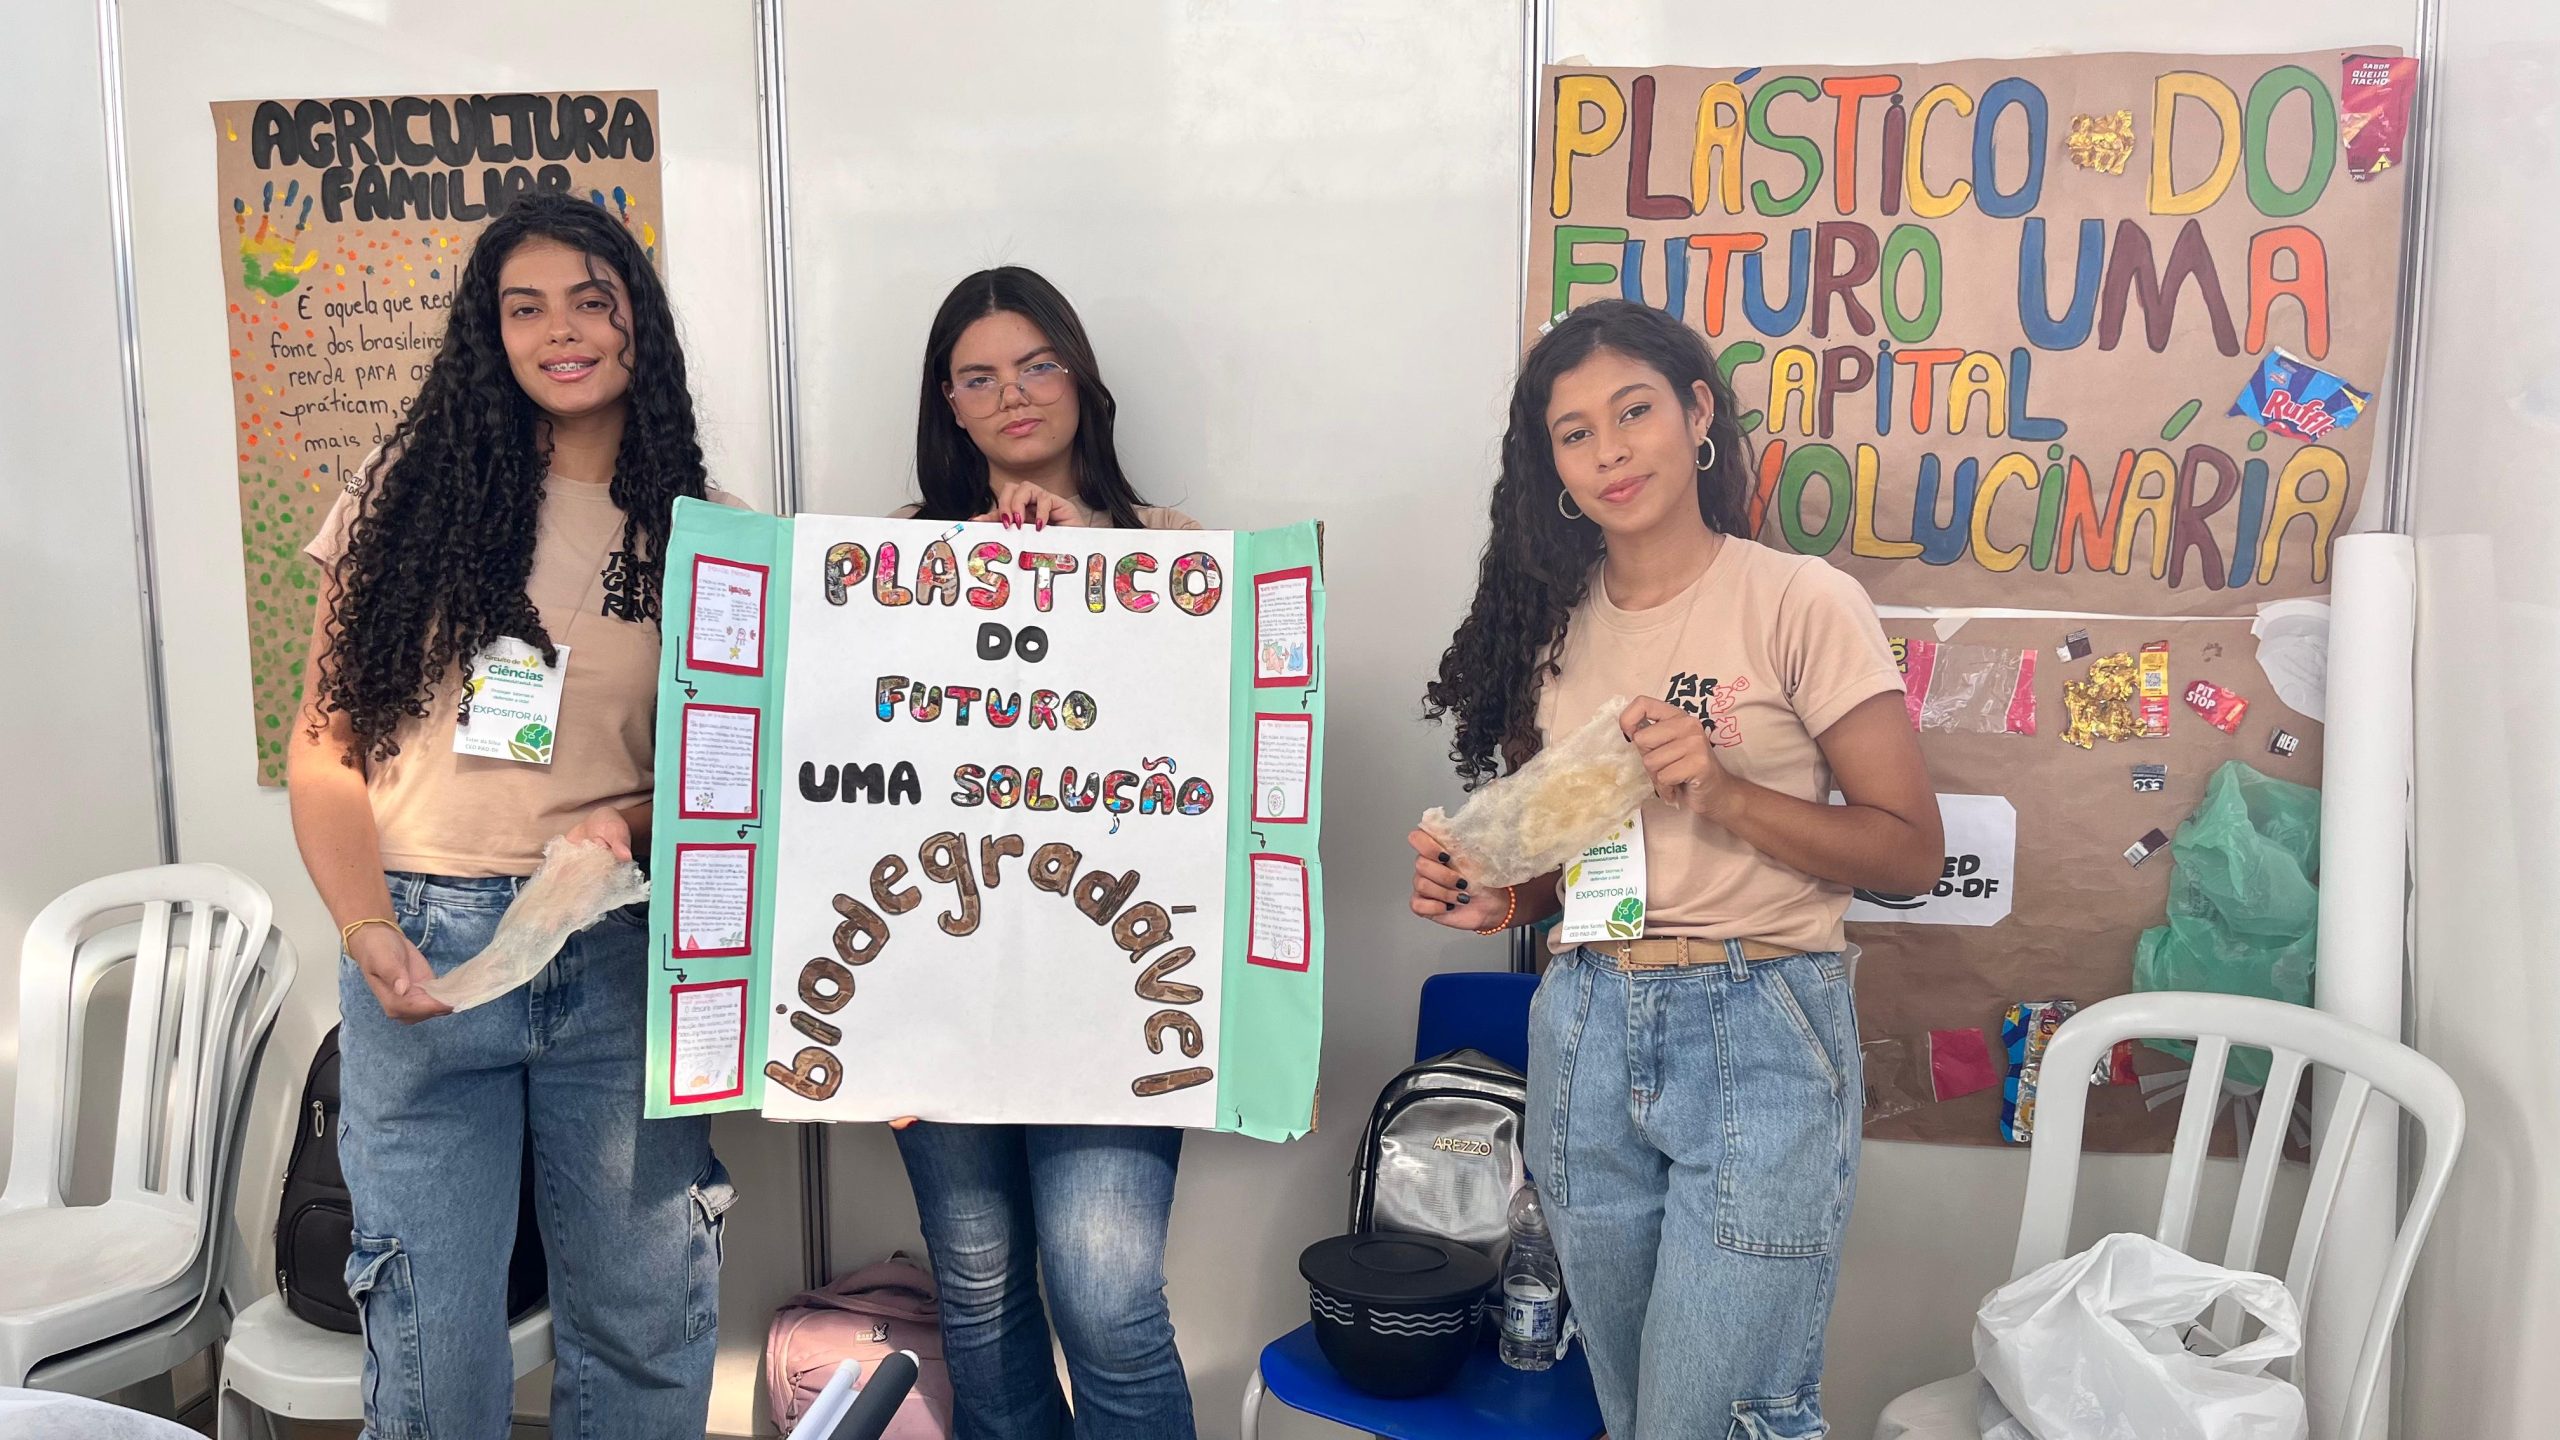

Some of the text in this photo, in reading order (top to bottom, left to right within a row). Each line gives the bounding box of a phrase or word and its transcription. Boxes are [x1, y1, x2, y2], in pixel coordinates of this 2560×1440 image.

[2352, 70, 2389, 78] QUEIJO
[252, 94, 654, 169] AGRICULTURA
[2145, 64, 2337, 217] DO
[298, 286, 314, 319] É
[325, 280, 378, 327] aquela
[383, 296, 413, 322] que
[1550, 217, 2330, 361] FUTURO UMA
[270, 331, 317, 358] fome
[327, 326, 354, 355] dos
[304, 427, 360, 452] mais
[824, 523, 1223, 616] PLÁSTICO
[976, 622, 1049, 663] DO
[488, 664, 544, 681] Ciências
[473, 705, 547, 723] EXPOSITOR (A)
[875, 675, 1097, 730] FUTURO
[2186, 690, 2216, 710] STOP
[798, 761, 922, 805] UMA
[951, 756, 1214, 835] SOLUÇÃO
[1576, 886, 1638, 899] EXPOSITOR (A)
[1432, 1135, 1492, 1156] AREZZO
